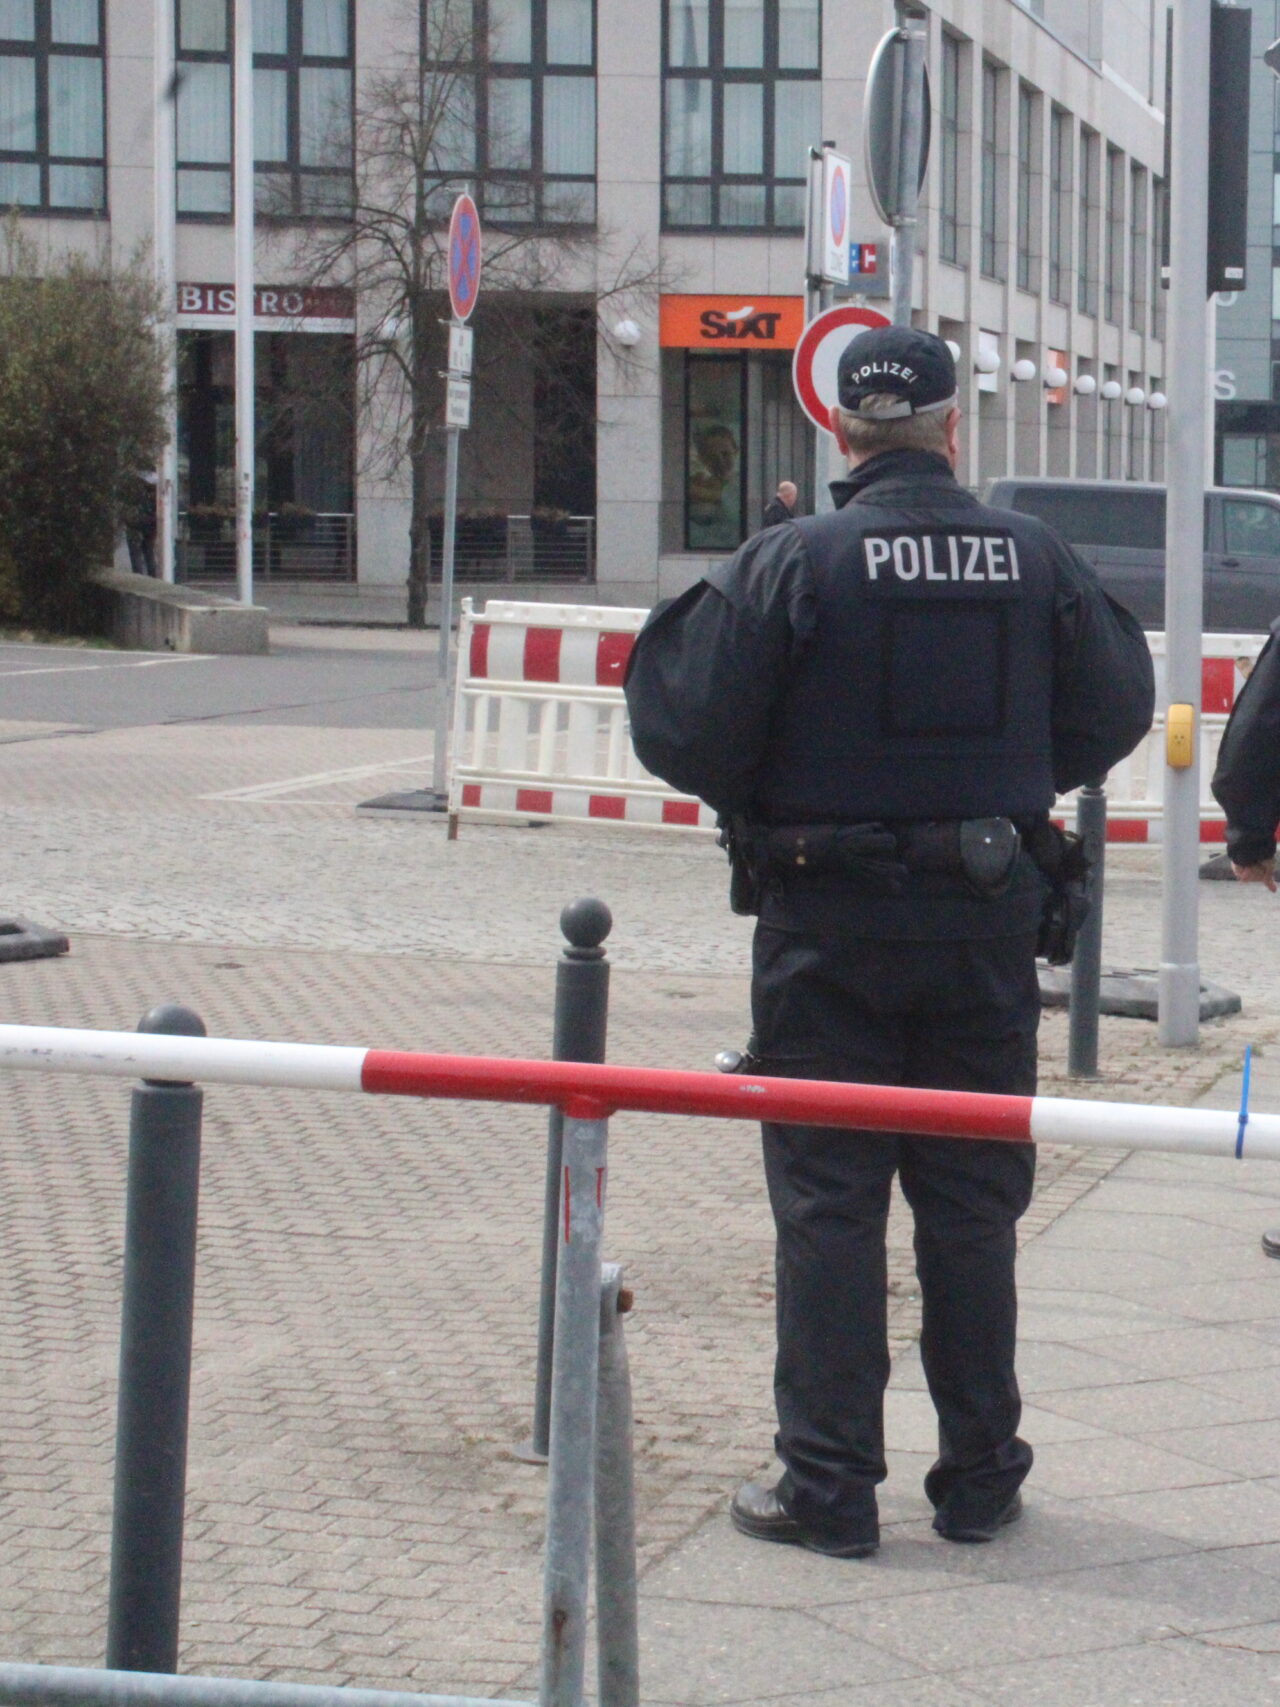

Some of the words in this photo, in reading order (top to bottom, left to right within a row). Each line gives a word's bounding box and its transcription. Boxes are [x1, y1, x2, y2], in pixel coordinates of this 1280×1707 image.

[181, 286, 304, 314] BISRO
[851, 361, 918, 384] POLIZEI
[864, 536, 1020, 581] POLIZEI
